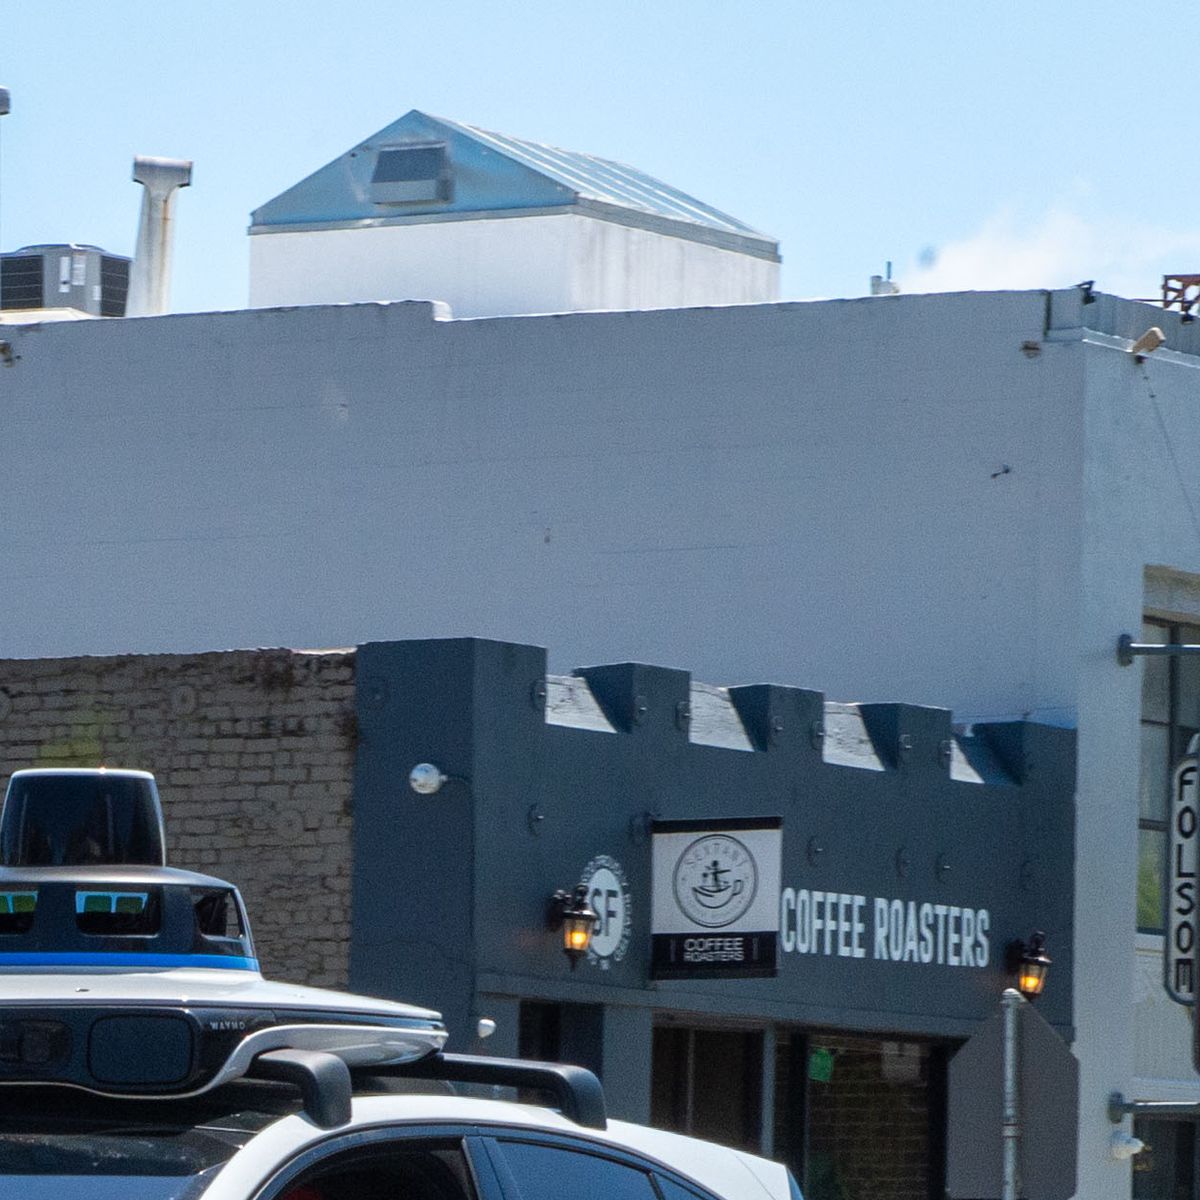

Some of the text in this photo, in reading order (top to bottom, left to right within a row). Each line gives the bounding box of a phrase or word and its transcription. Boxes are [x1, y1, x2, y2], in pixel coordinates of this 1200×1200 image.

[1175, 765, 1198, 993] FOLSOM
[591, 888, 619, 937] SF
[781, 886, 990, 968] COFFEE ROASTERS
[683, 951, 745, 962] ROASTERS
[684, 938, 744, 951] COFFEE
[210, 1020, 246, 1030] WAYMO
